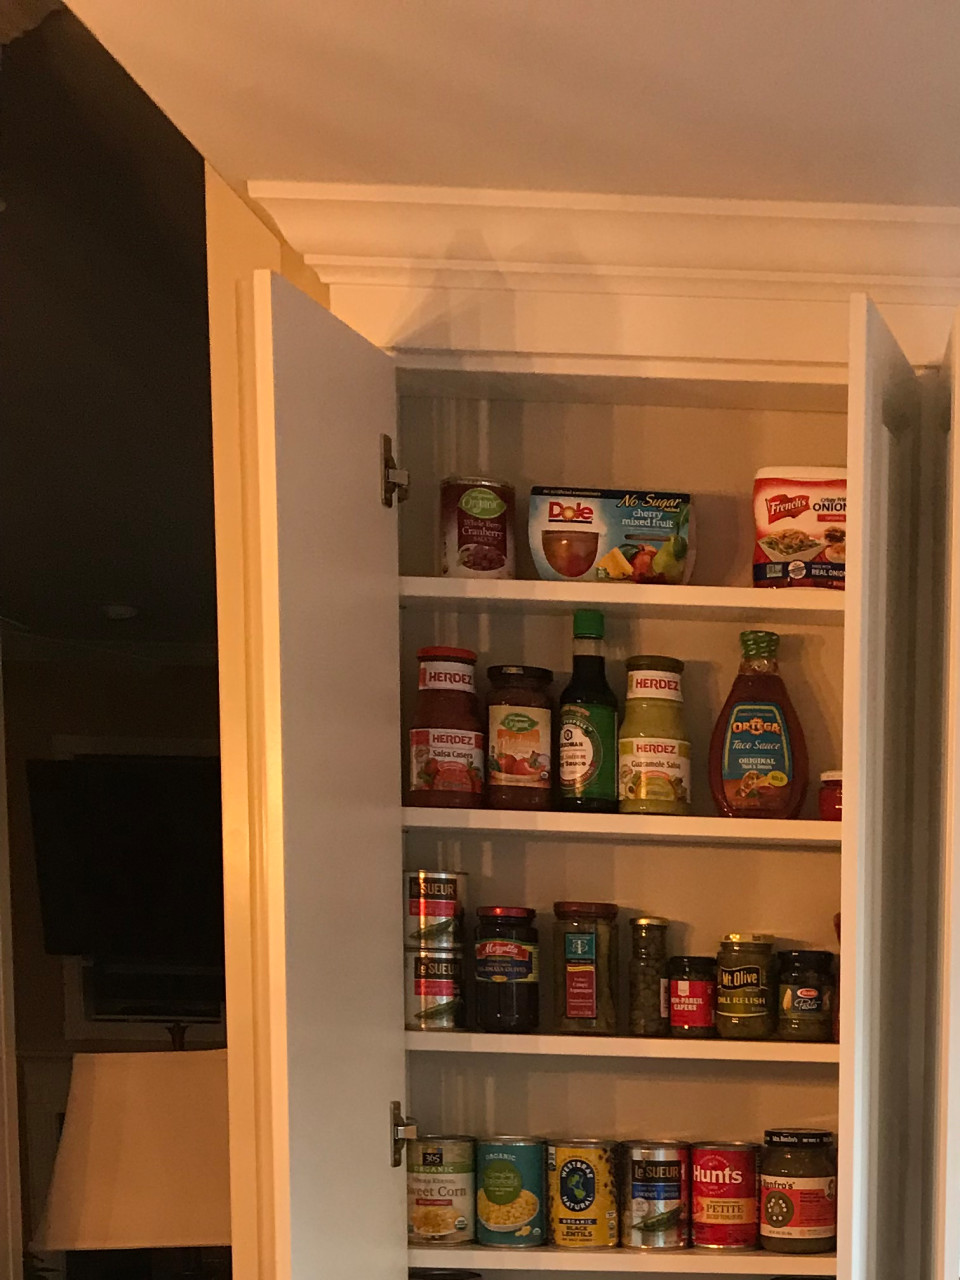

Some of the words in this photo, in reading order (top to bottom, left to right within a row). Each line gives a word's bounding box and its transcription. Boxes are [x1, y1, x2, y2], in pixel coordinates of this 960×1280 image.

[618, 496, 638, 508] No
[641, 494, 682, 510] Sugar
[769, 497, 807, 515] French's
[548, 501, 594, 520] Dole
[632, 508, 663, 520] cherry
[621, 517, 650, 528] mixed
[651, 519, 674, 528] fruit
[461, 527, 504, 539] Cranberry
[428, 672, 473, 686] HERDEZ
[635, 678, 679, 691] HERDEZ
[732, 717, 781, 735] ORTEGA
[432, 733, 474, 746] HERDEZ
[732, 739, 751, 750] Taco
[753, 739, 781, 750] Sauce
[432, 750, 452, 759] Salsa
[636, 743, 676, 754] HERDEZ
[631, 760, 664, 769] Guacamole
[738, 757, 776, 765] ORIGINAL
[422, 883, 455, 895] SUEUR
[734, 970, 758, 986] Olive
[425, 1154, 440, 1163] 365
[485, 1152, 516, 1161] ORGANIC
[561, 1161, 594, 1178] WESTBRAE
[646, 1166, 679, 1178] SUEUR
[438, 1185, 467, 1197] Corn
[561, 1194, 594, 1210] NATURAL
[706, 1204, 744, 1214] PETITE
